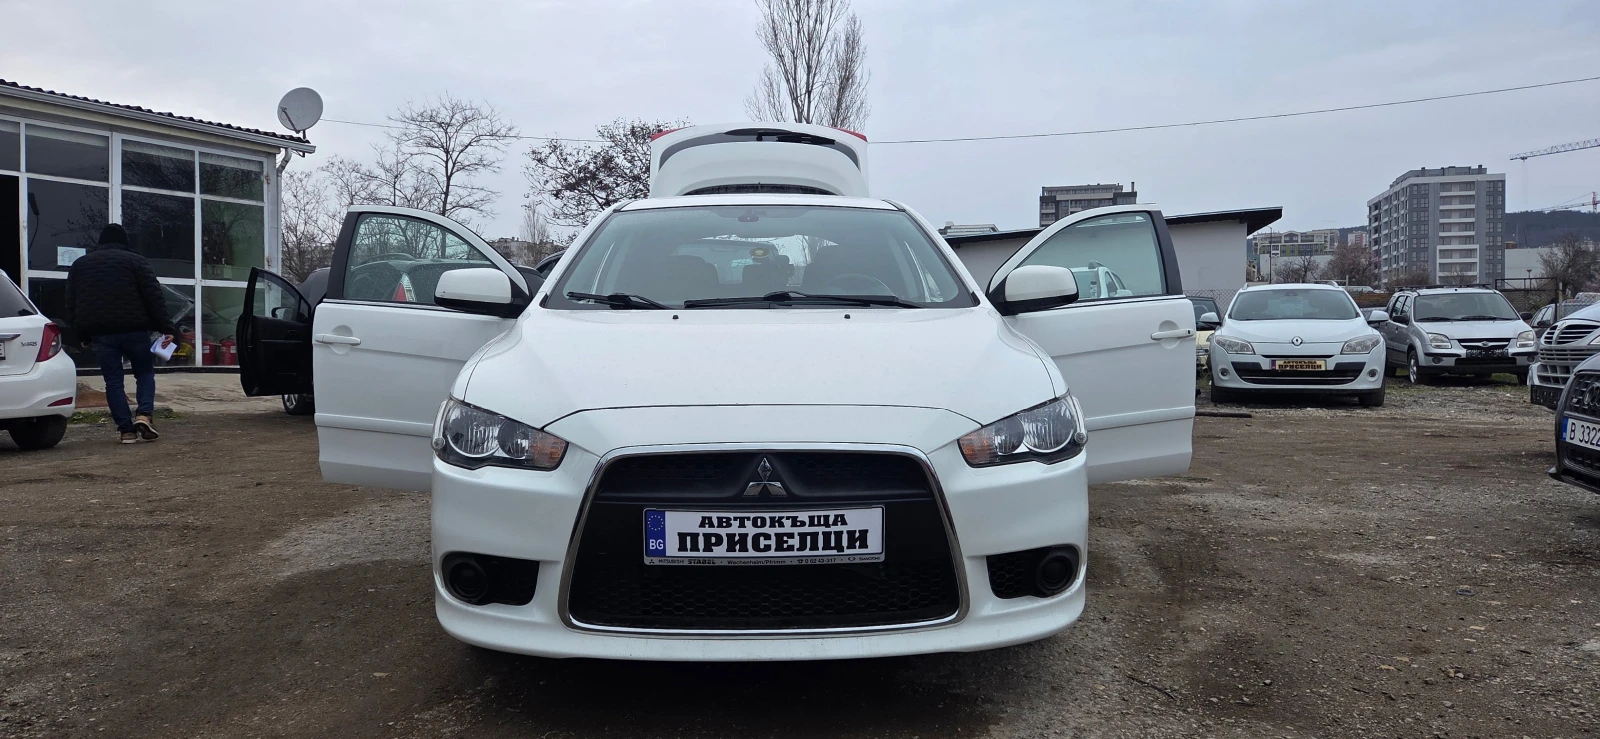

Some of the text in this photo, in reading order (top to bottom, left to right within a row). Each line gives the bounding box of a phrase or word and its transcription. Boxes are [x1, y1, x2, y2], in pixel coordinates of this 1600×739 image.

[698, 513, 848, 529] АВТОКЪЩА
[649, 539, 664, 550] BG
[677, 529, 869, 553] ПРИСЕЛЦИ
